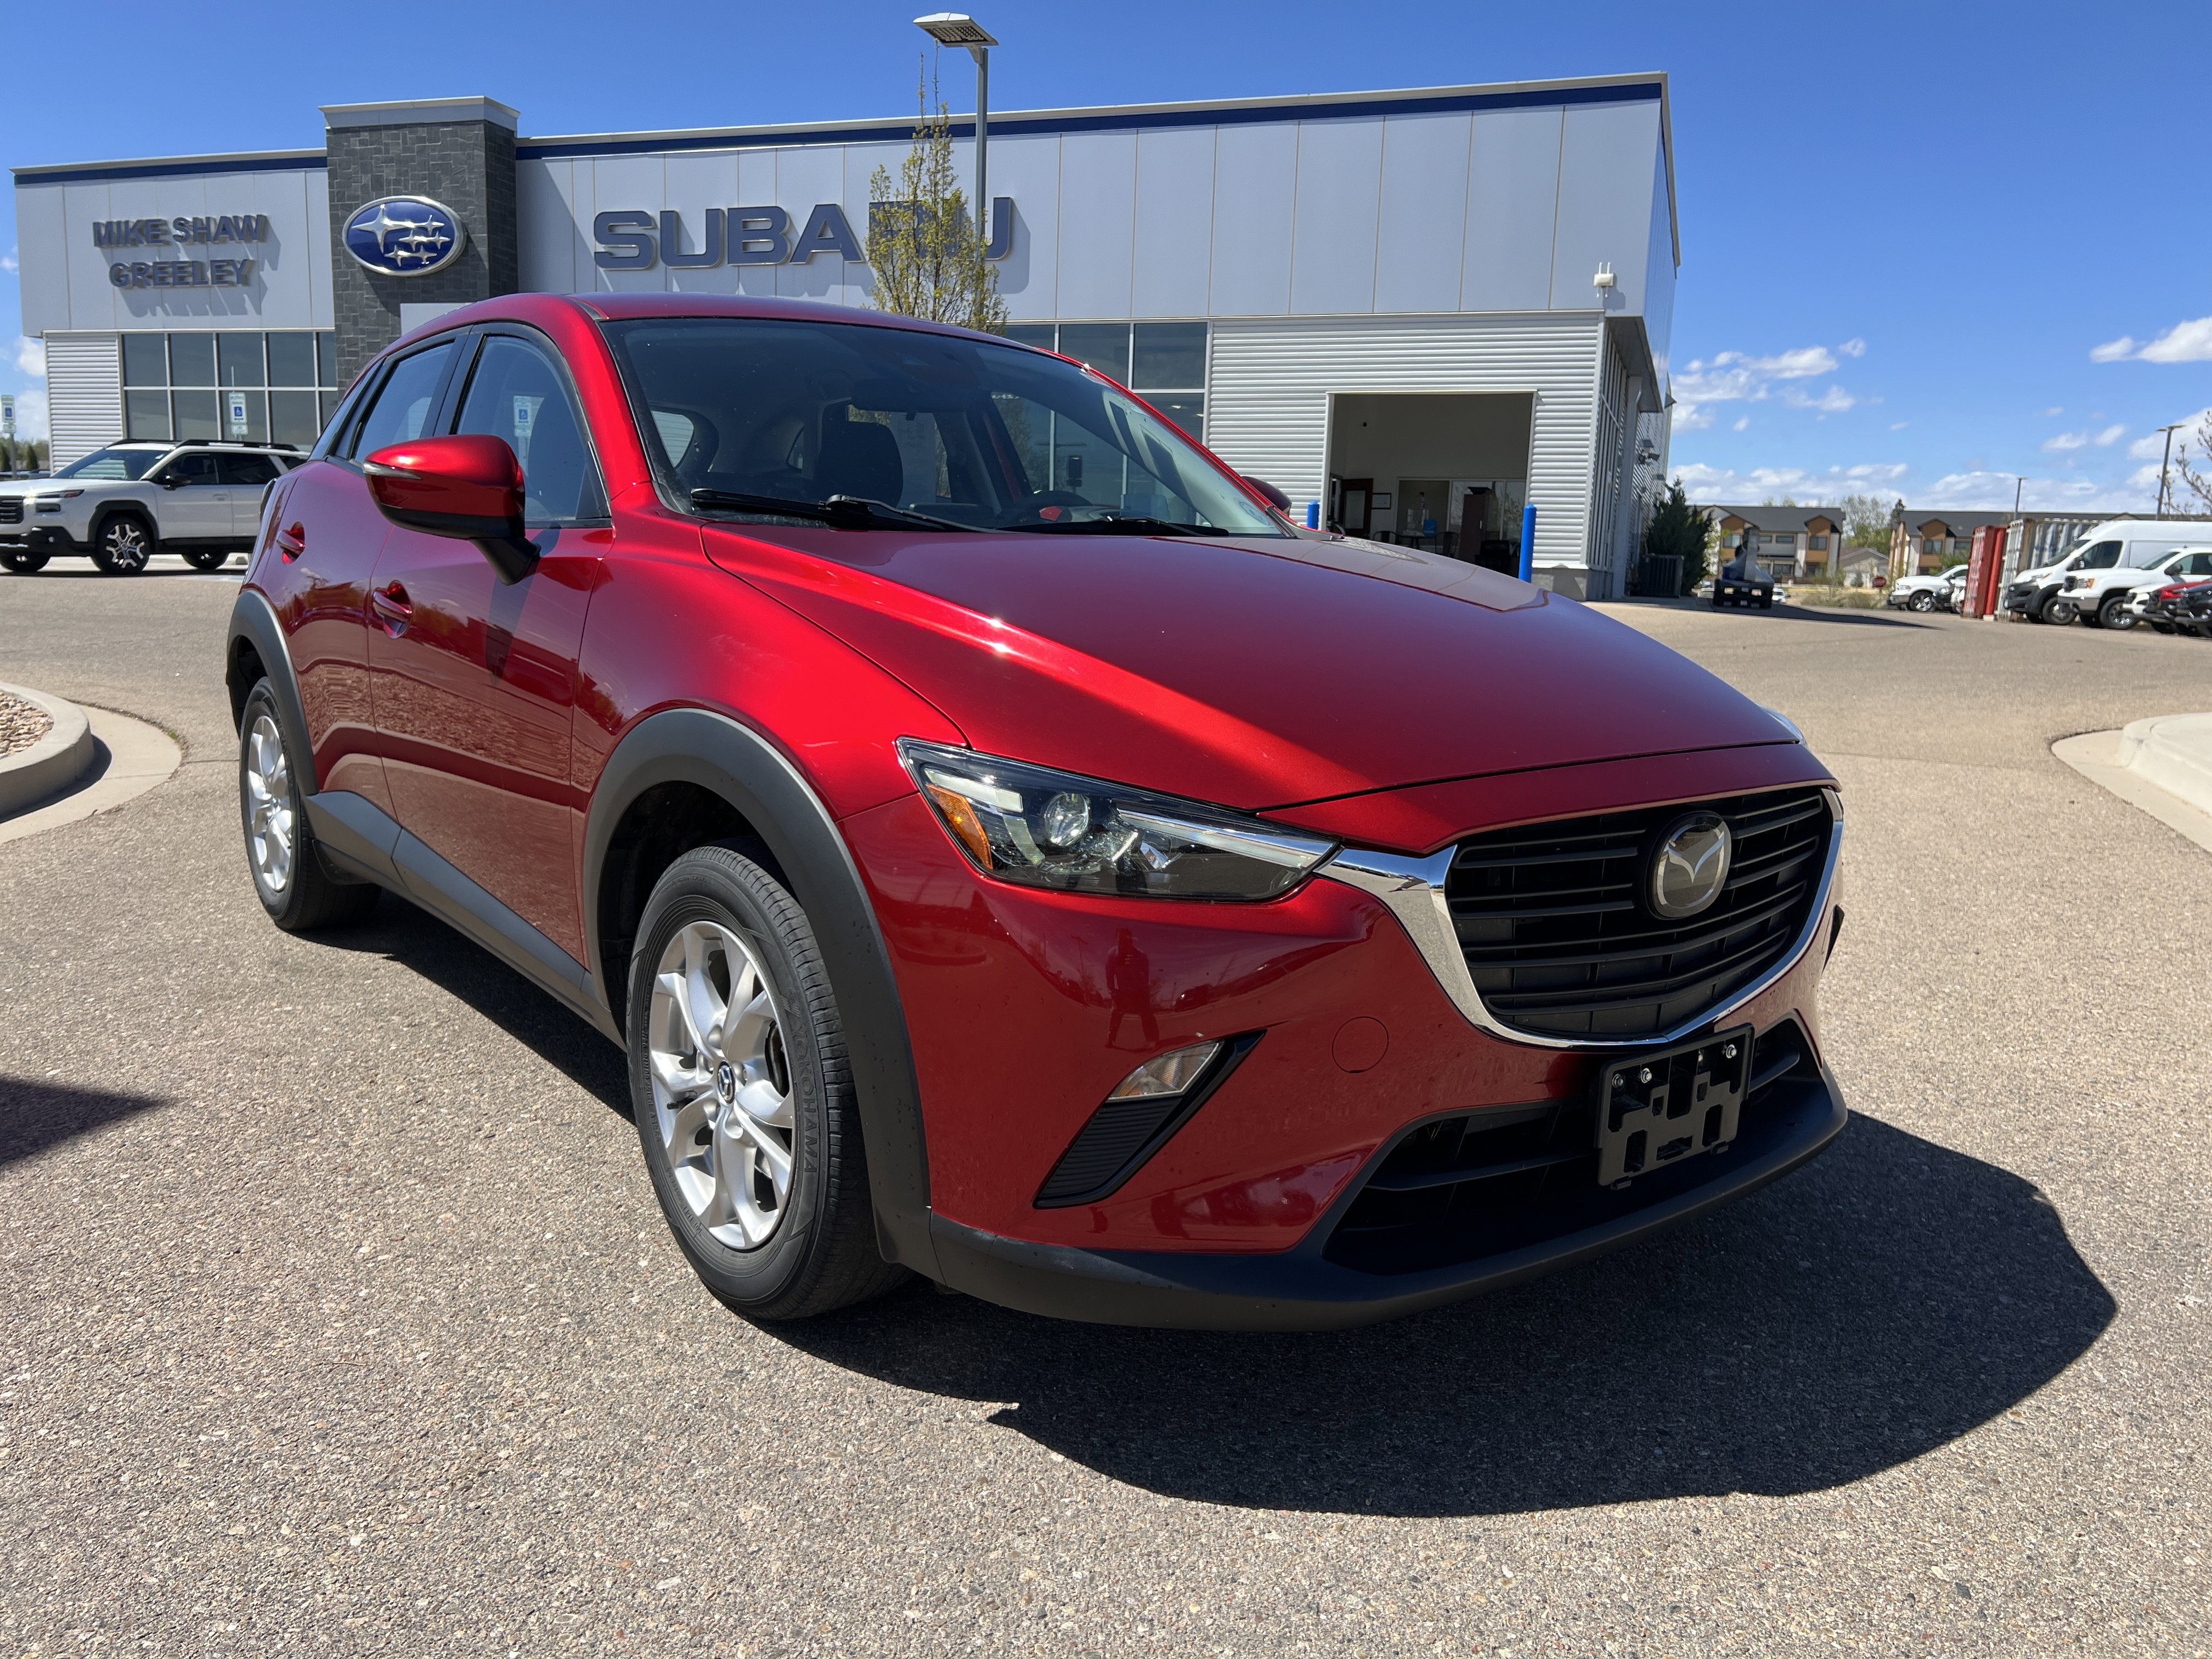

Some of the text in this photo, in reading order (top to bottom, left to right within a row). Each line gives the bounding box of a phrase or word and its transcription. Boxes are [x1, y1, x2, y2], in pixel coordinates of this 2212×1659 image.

[92, 213, 269, 247] MIKE SHAW
[109, 259, 254, 289] GREELEY
[792, 1024, 818, 1173] YOKOHAMA
